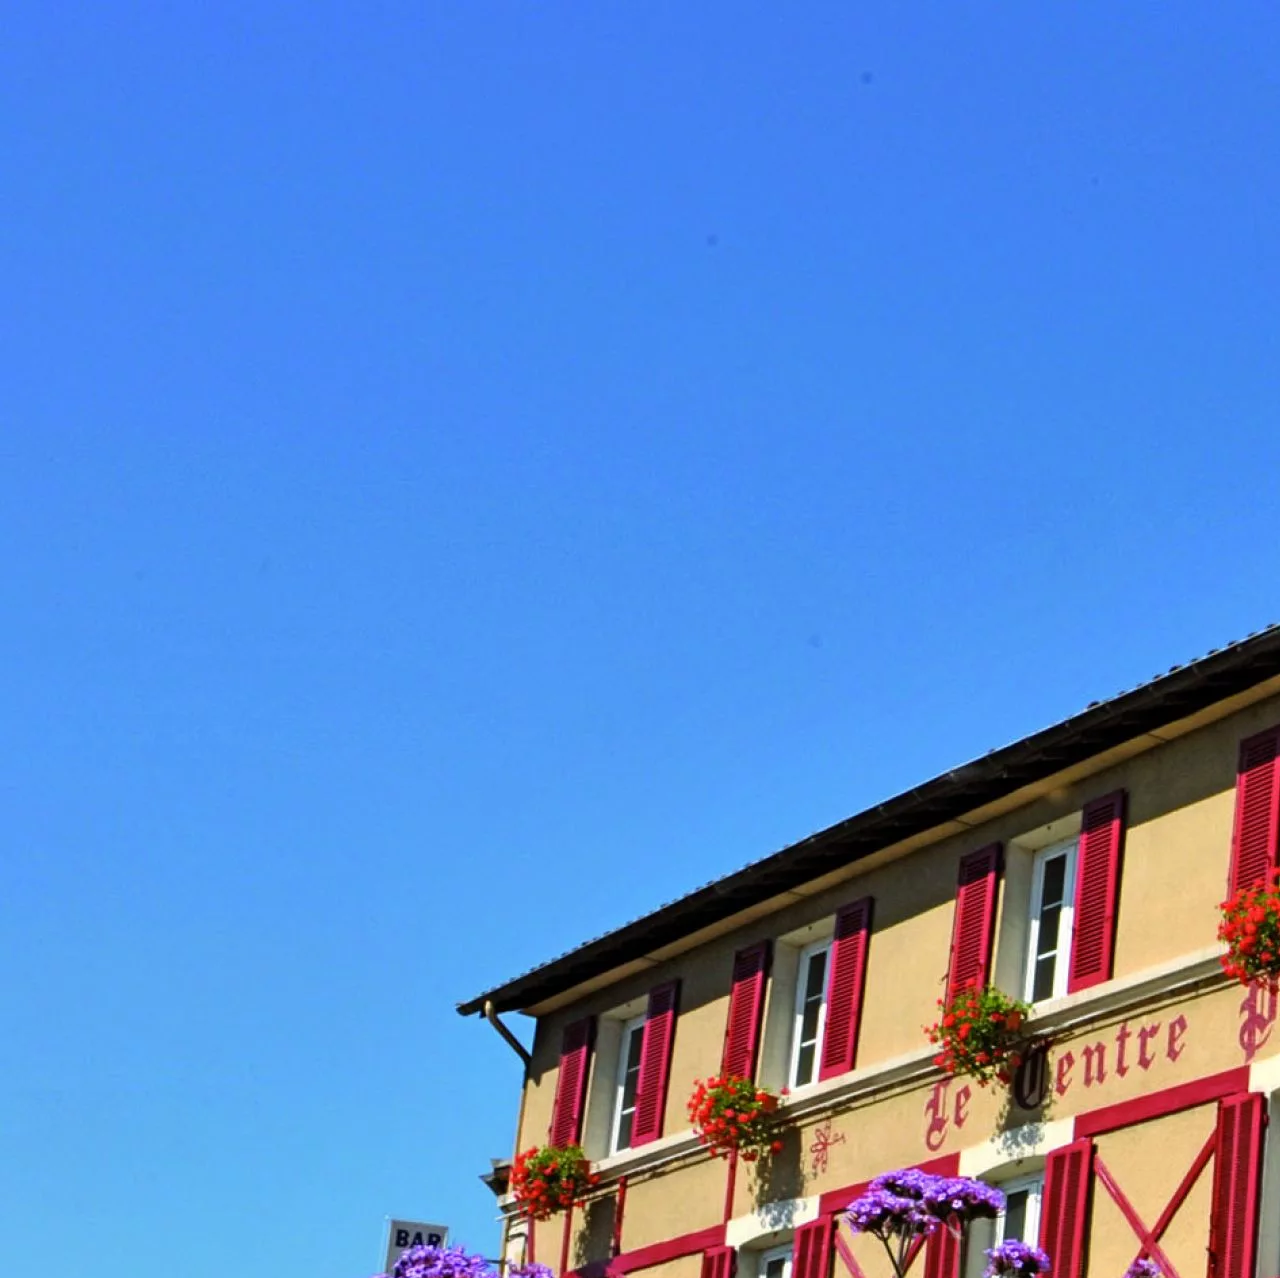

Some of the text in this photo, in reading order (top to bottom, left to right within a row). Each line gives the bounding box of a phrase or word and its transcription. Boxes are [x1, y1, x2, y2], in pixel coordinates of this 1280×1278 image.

[925, 1074, 972, 1151] Le
[1014, 1014, 1188, 1110] Centre
[395, 1229, 441, 1250] BAR
